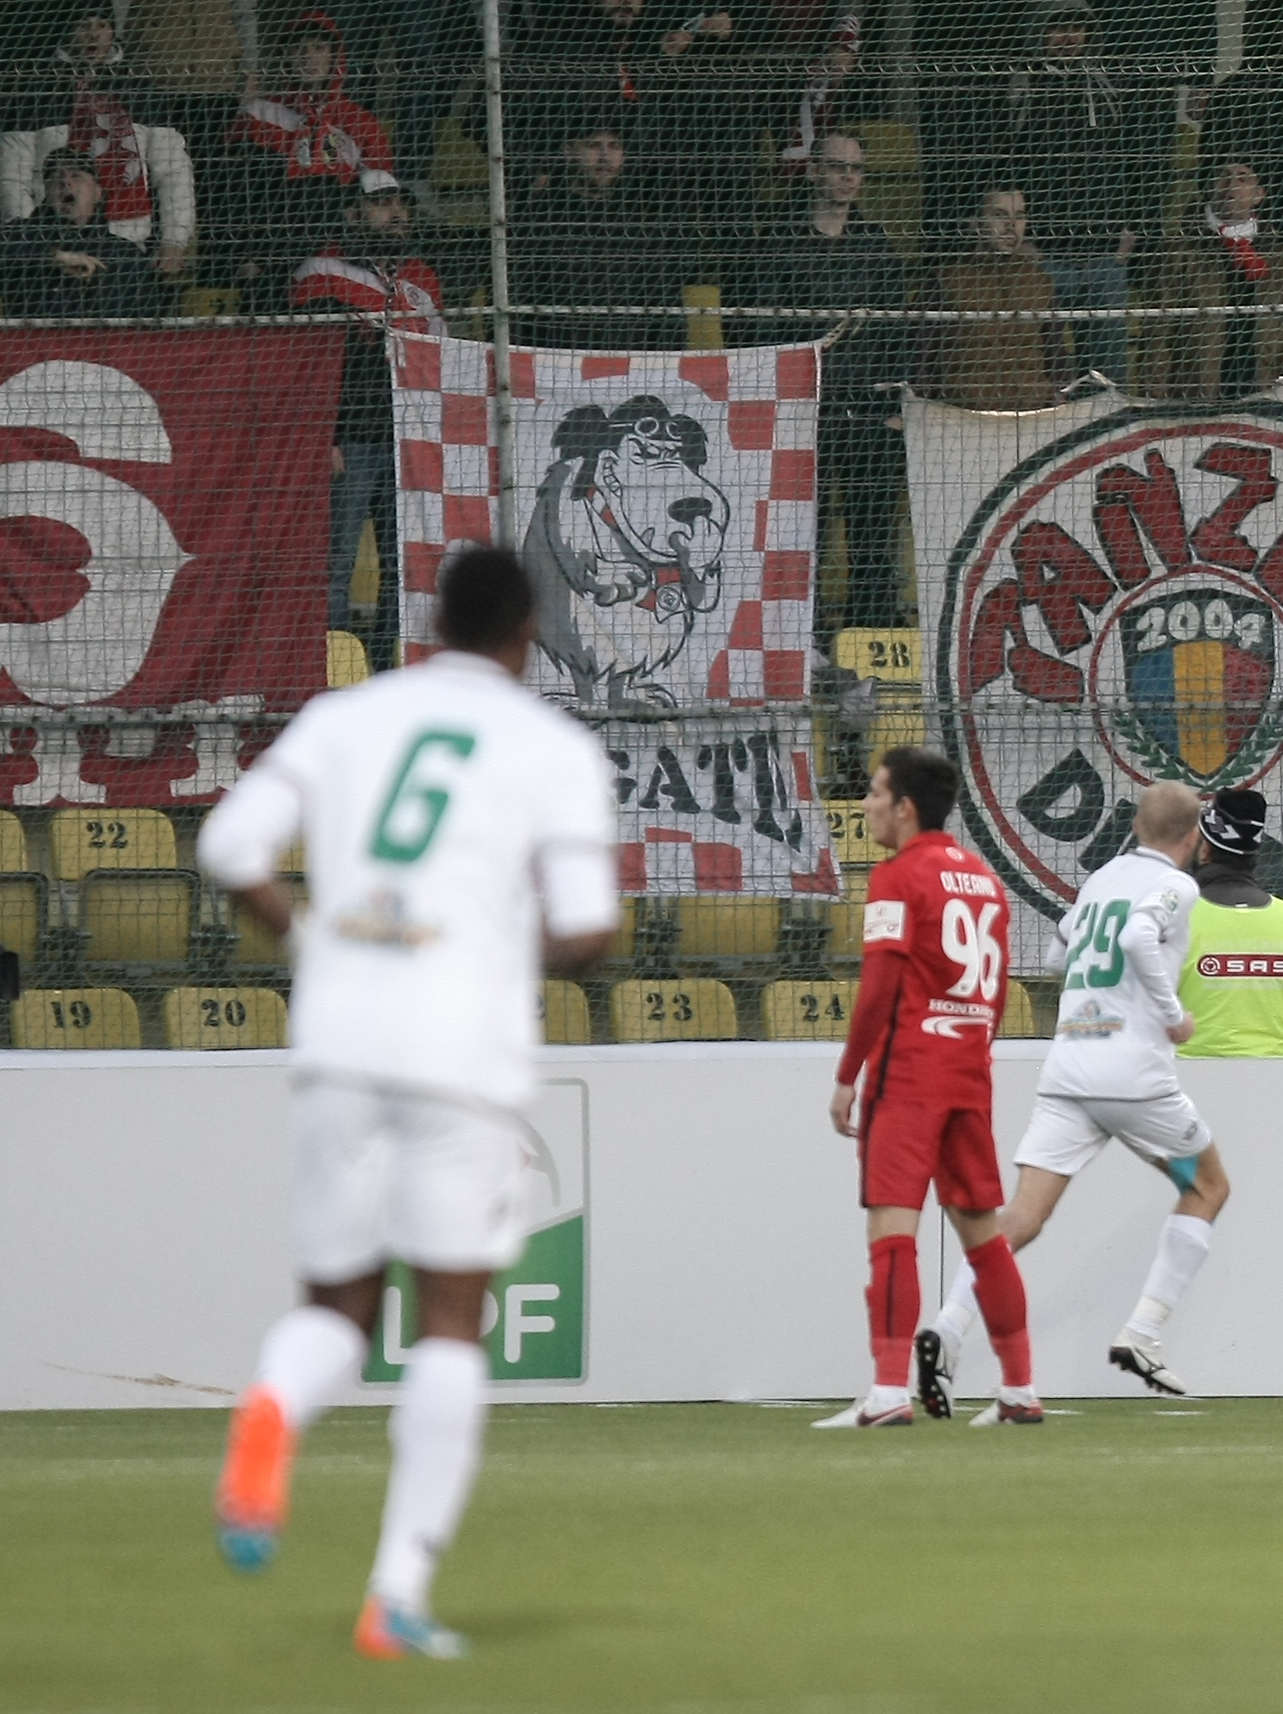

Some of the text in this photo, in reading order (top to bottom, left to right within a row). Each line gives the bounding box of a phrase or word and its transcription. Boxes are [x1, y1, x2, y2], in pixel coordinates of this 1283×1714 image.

[1135, 598, 1266, 652] 2004
[868, 641, 911, 669] 28
[369, 725, 477, 863] 6
[86, 820, 129, 850] 22
[826, 811, 866, 840] 27
[941, 897, 1000, 1002] 96
[1064, 898, 1131, 990] 29
[49, 999, 92, 1028] 19
[203, 999, 247, 1027] 20
[646, 993, 693, 1021] 23
[801, 993, 845, 1021] 24
[382, 1283, 562, 1365] LF
